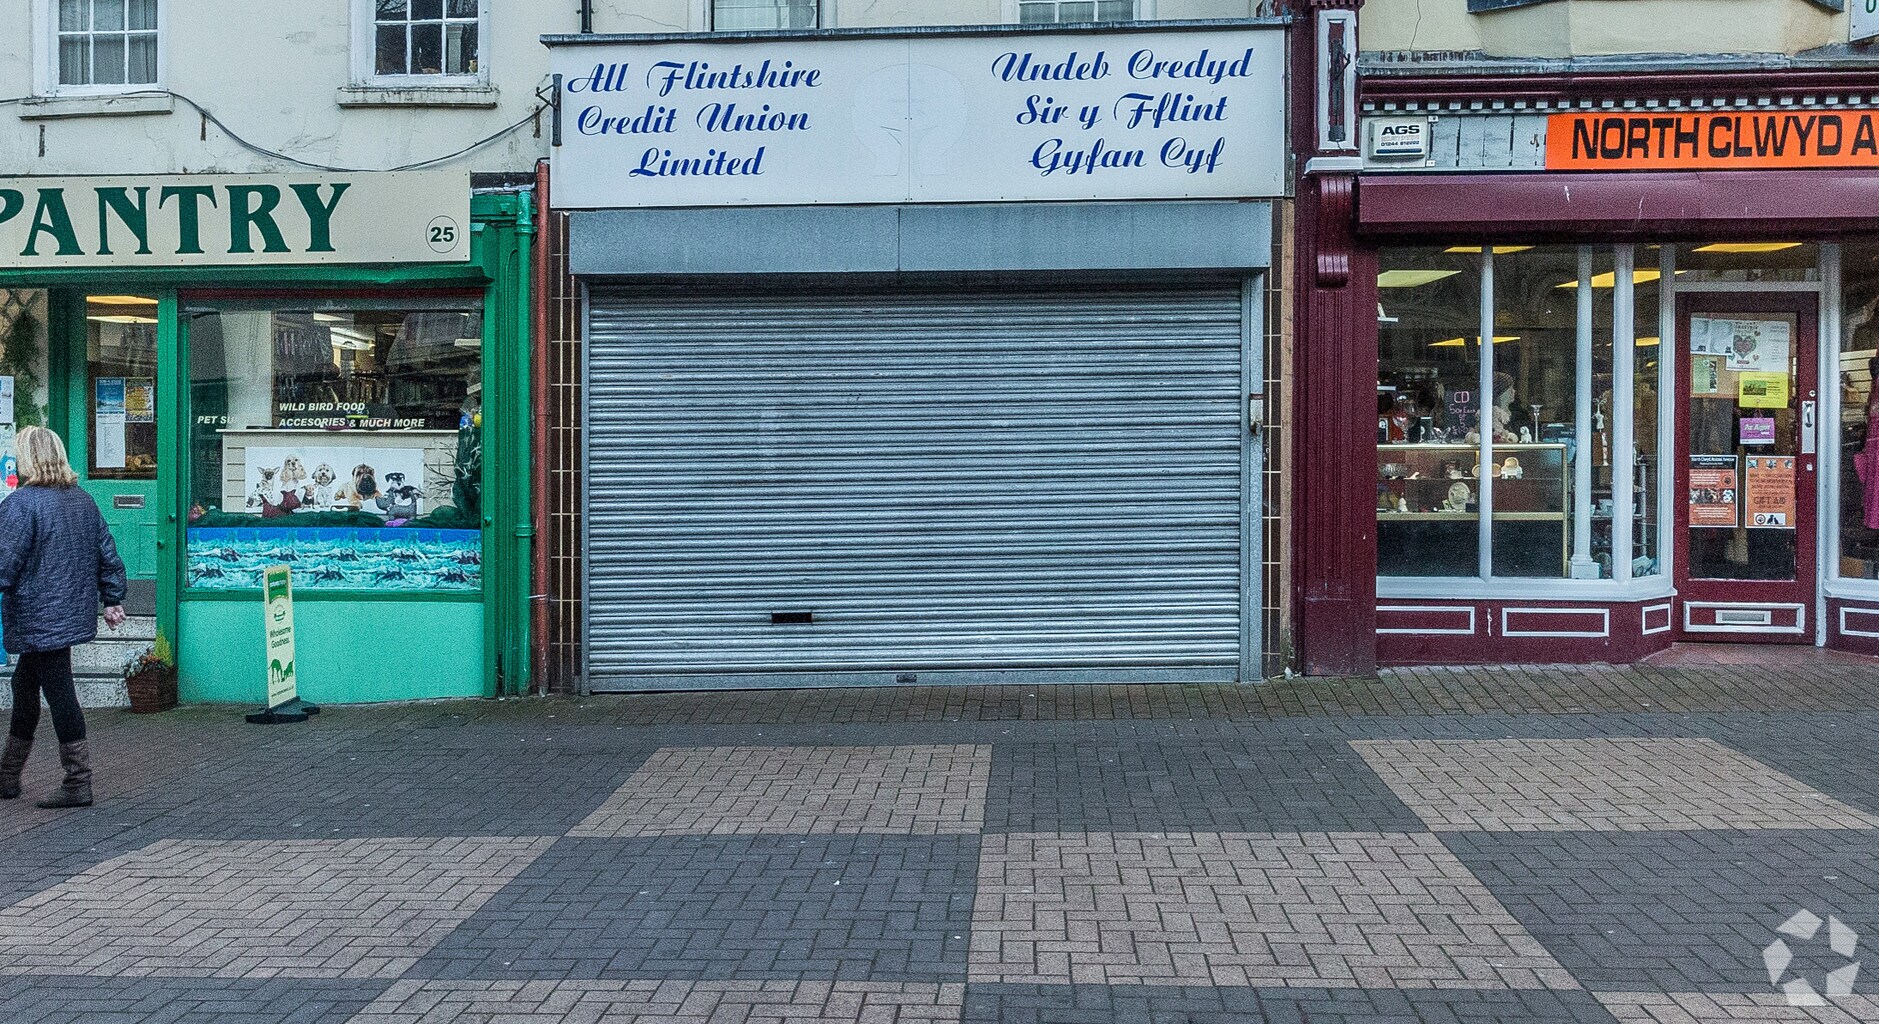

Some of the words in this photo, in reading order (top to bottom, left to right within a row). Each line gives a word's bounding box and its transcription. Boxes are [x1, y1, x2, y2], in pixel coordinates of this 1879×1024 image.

[567, 63, 629, 93] All
[646, 59, 823, 97] Flintshire
[991, 51, 1111, 82] Undeb
[1127, 48, 1254, 85] Credyd
[577, 105, 678, 136] Credit
[696, 102, 812, 133] Union
[1016, 95, 1069, 125] Sir
[1079, 105, 1102, 130] y
[1113, 92, 1229, 129] Fflint
[1381, 125, 1420, 135] AGS
[1571, 117, 1700, 159] NORTH
[1708, 114, 1842, 158] CLWYD
[1851, 114, 1878, 155] A
[629, 145, 766, 178] Limited
[1028, 138, 1146, 177] Gyfan
[1160, 137, 1225, 174] Cyf
[430, 226, 455, 243] 25
[279, 402, 306, 411] WILD
[308, 402, 334, 411] BIRD
[336, 401, 365, 411] FOOD
[1453, 390, 1470, 404] CD
[197, 415, 218, 424] PET
[279, 417, 346, 427] ACCESORIES
[348, 419, 356, 427] &
[359, 419, 392, 427] MUCH
[393, 418, 425, 427] MORE
